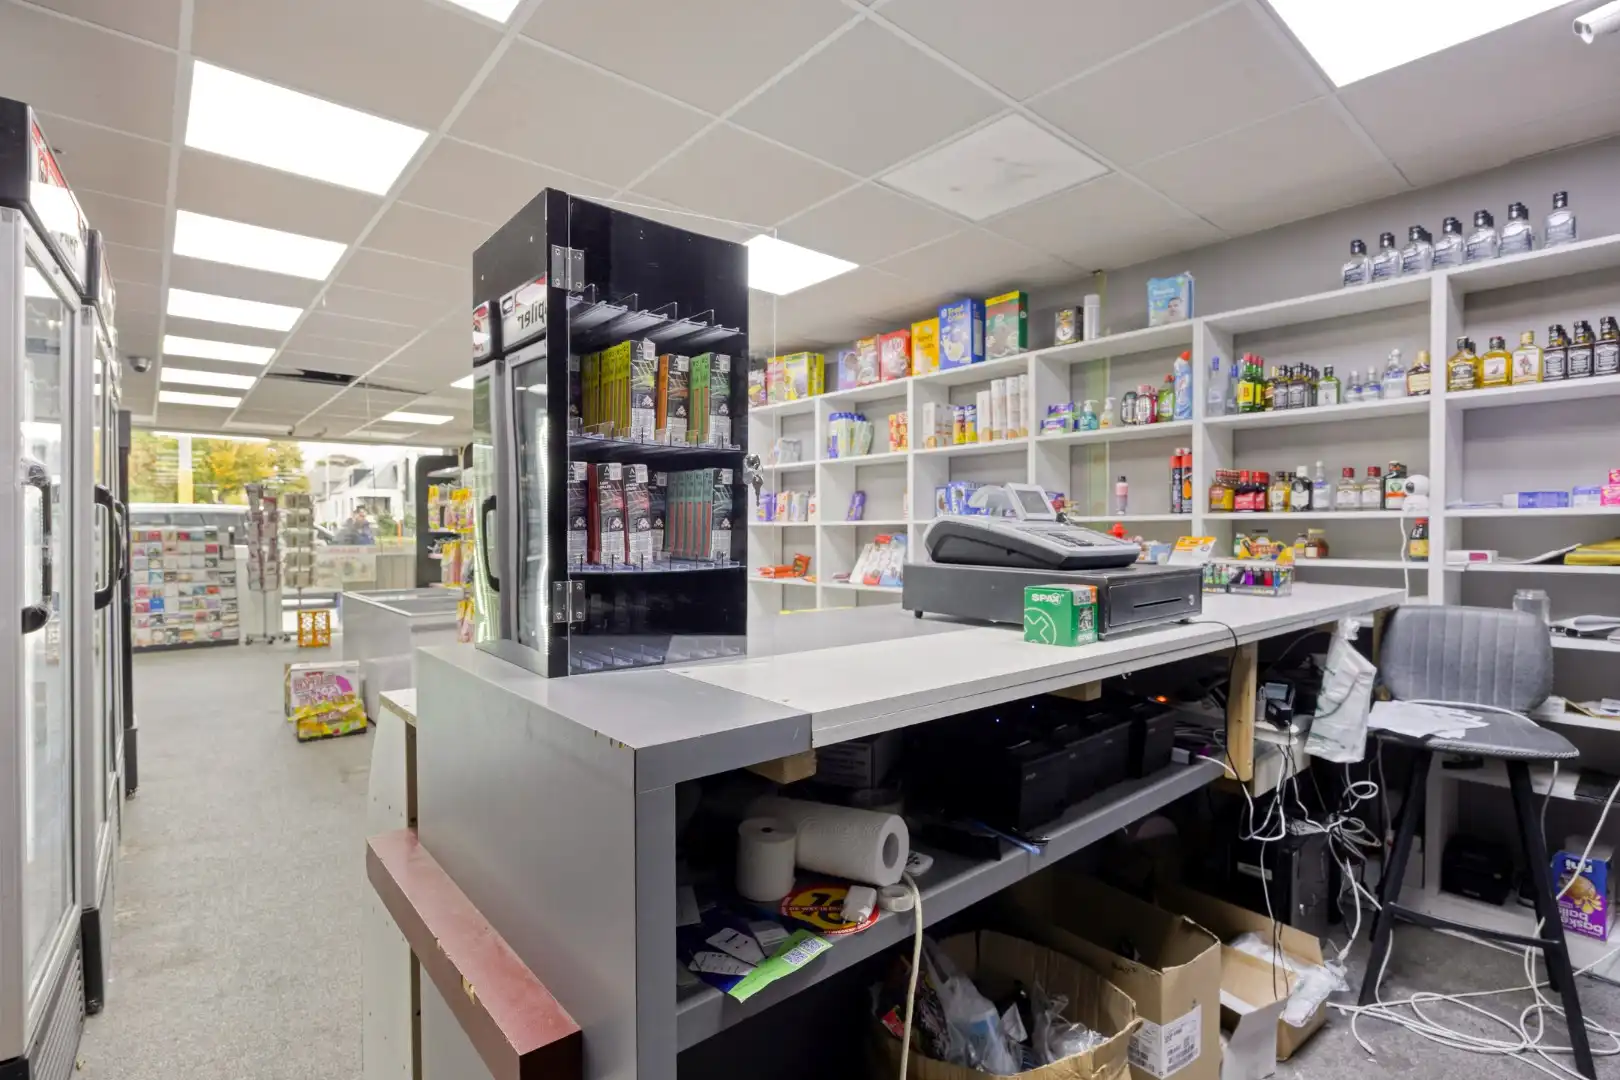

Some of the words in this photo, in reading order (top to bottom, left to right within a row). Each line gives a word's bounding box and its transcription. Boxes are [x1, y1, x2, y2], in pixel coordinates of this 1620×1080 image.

[1031, 593, 1061, 605] SPAX
[1566, 859, 1593, 873] Fni
[1560, 916, 1604, 936] baske
